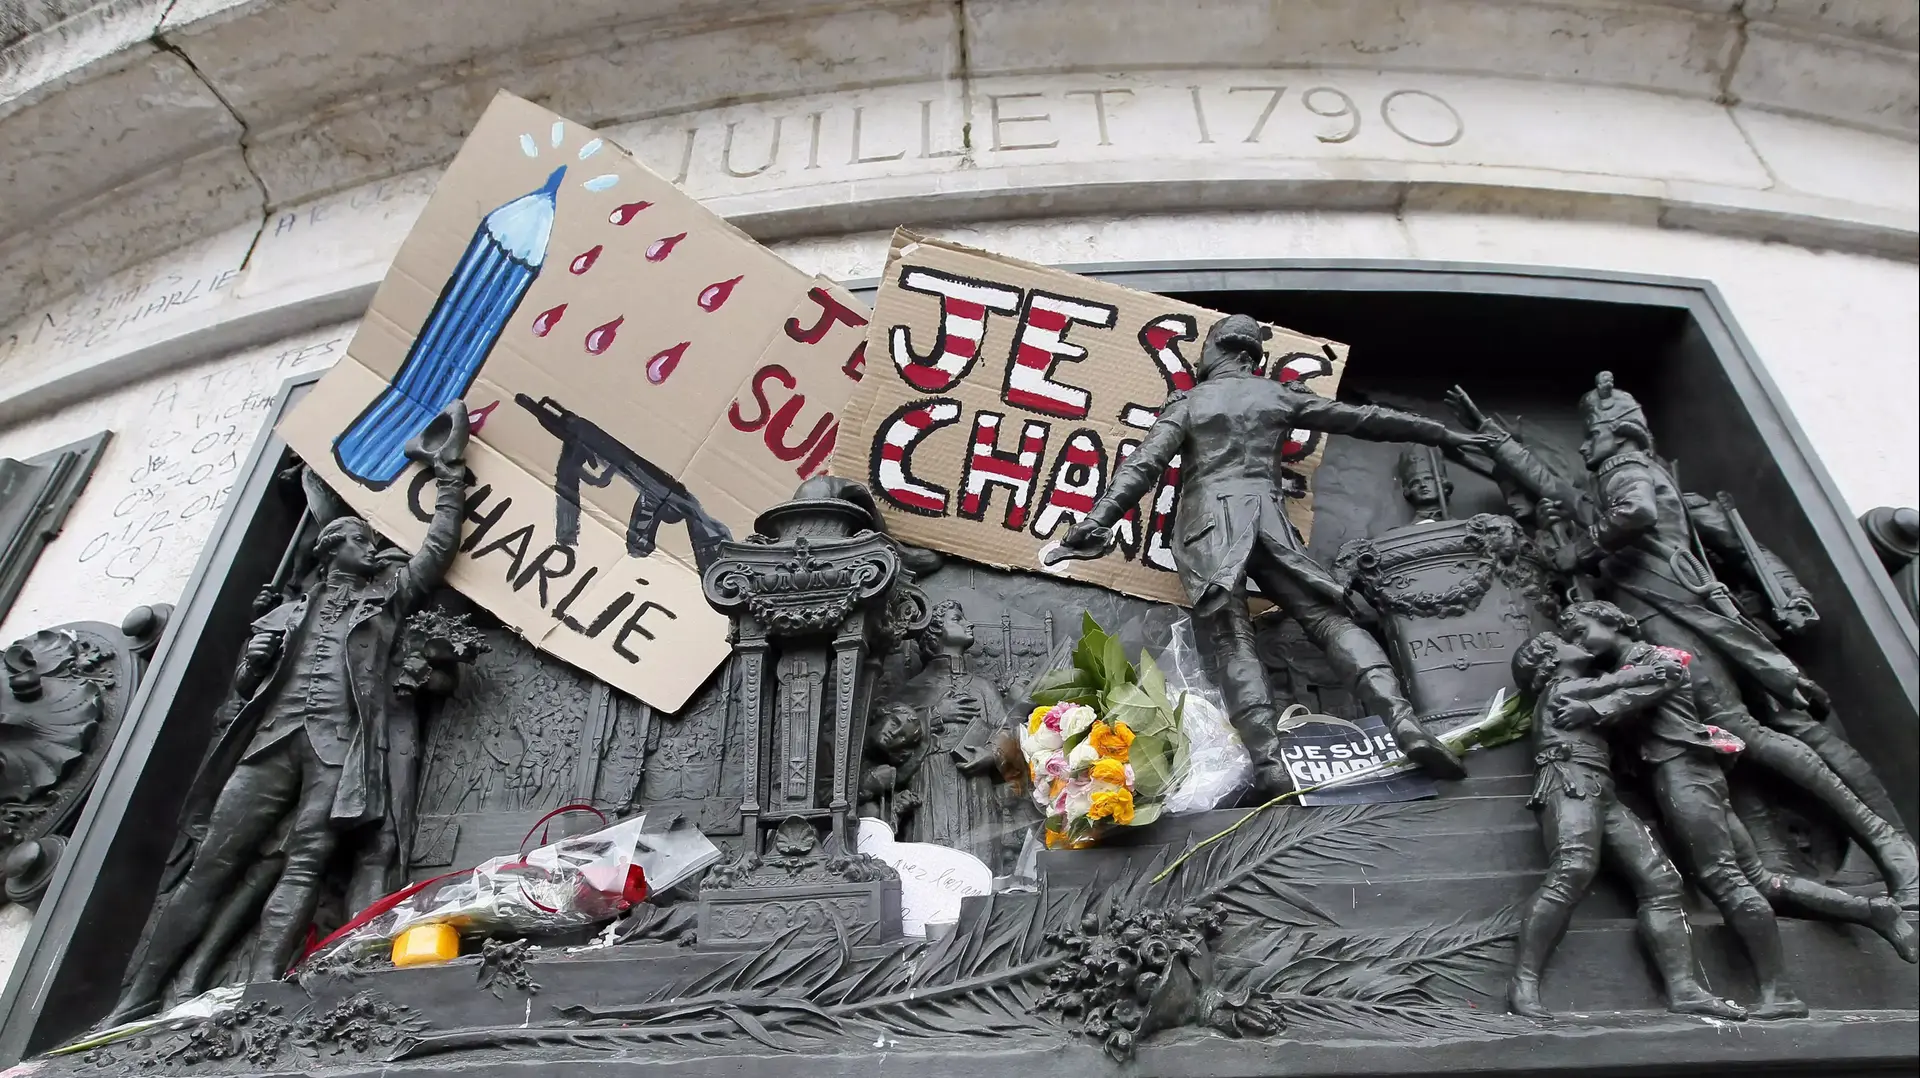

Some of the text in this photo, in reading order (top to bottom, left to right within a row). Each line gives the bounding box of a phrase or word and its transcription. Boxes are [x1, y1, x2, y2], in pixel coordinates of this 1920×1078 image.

[671, 85, 1464, 186] JUILLET 1790
[889, 264, 1119, 420] JE
[407, 466, 678, 664] CHARLIE
[1408, 631, 1505, 660] PATRIE
[1286, 745, 1327, 760] JE
